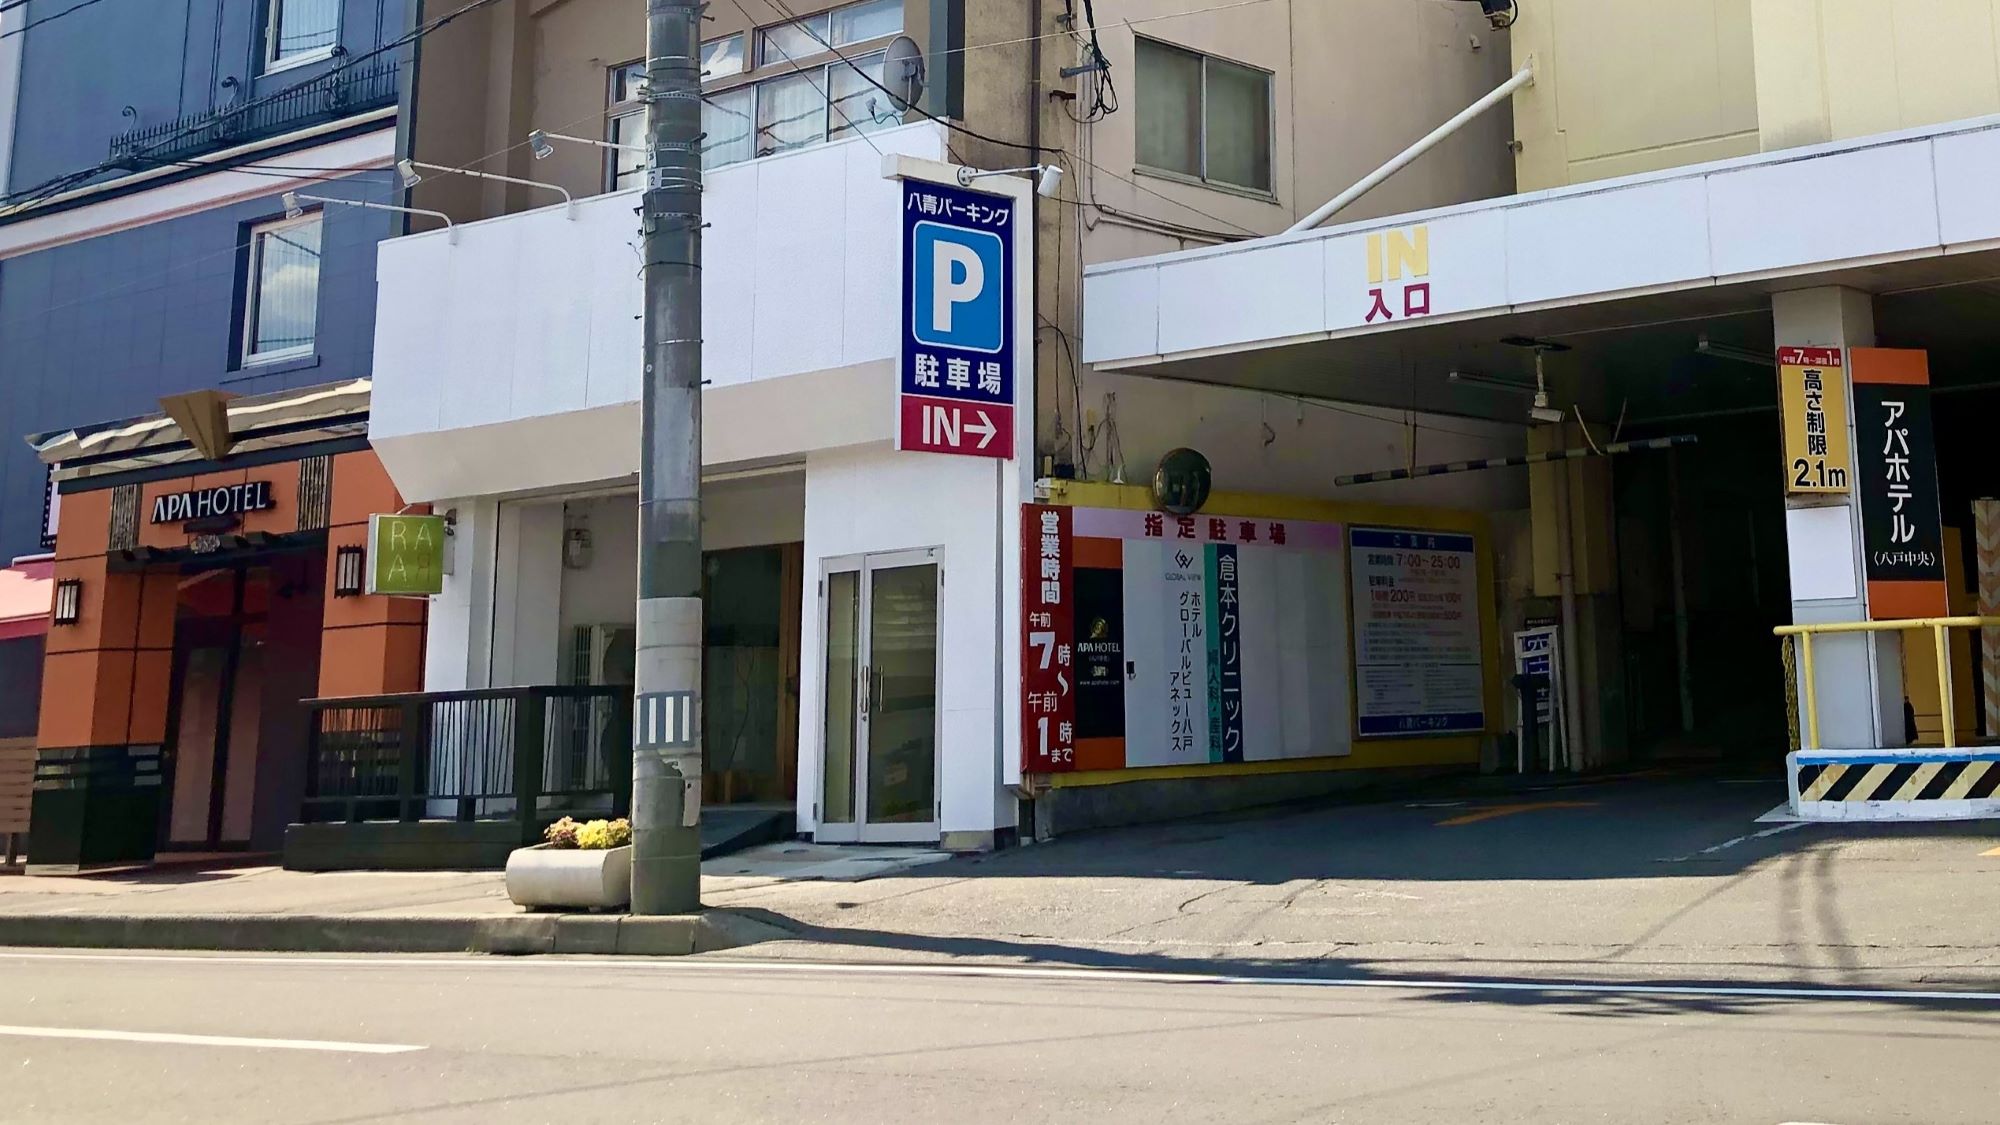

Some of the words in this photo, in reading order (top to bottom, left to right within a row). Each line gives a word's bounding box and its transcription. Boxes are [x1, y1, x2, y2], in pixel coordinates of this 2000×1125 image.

[907, 192, 1010, 227] 八青パーキング
[1368, 227, 1428, 283] IN
[933, 240, 985, 333] P
[1365, 282, 1431, 323] 入口
[914, 353, 1002, 395] 駐車場
[922, 404, 960, 447] IN
[1802, 369, 1827, 456] 高さ制限
[1793, 459, 1847, 488] 2.1m
[1881, 400, 1915, 544] アパホテル
[152, 493, 192, 522] APA
[197, 482, 266, 517] HOTEL
[1144, 513, 1286, 545] 指定駐車場
[1040, 511, 1060, 605] 営業時間
[1029, 611, 1051, 628] 午前
[1191, 592, 1202, 638] ホテル
[1077, 642, 1094, 653] APA
[1095, 642, 1120, 653] HOTEL
[1219, 555, 1240, 753] 倉本クリニック
[1179, 591, 1193, 751] グローバルビュー八戸
[1028, 691, 1057, 713] 午前
[1170, 672, 1183, 752] アネックス
[1051, 748, 1073, 763] まで
